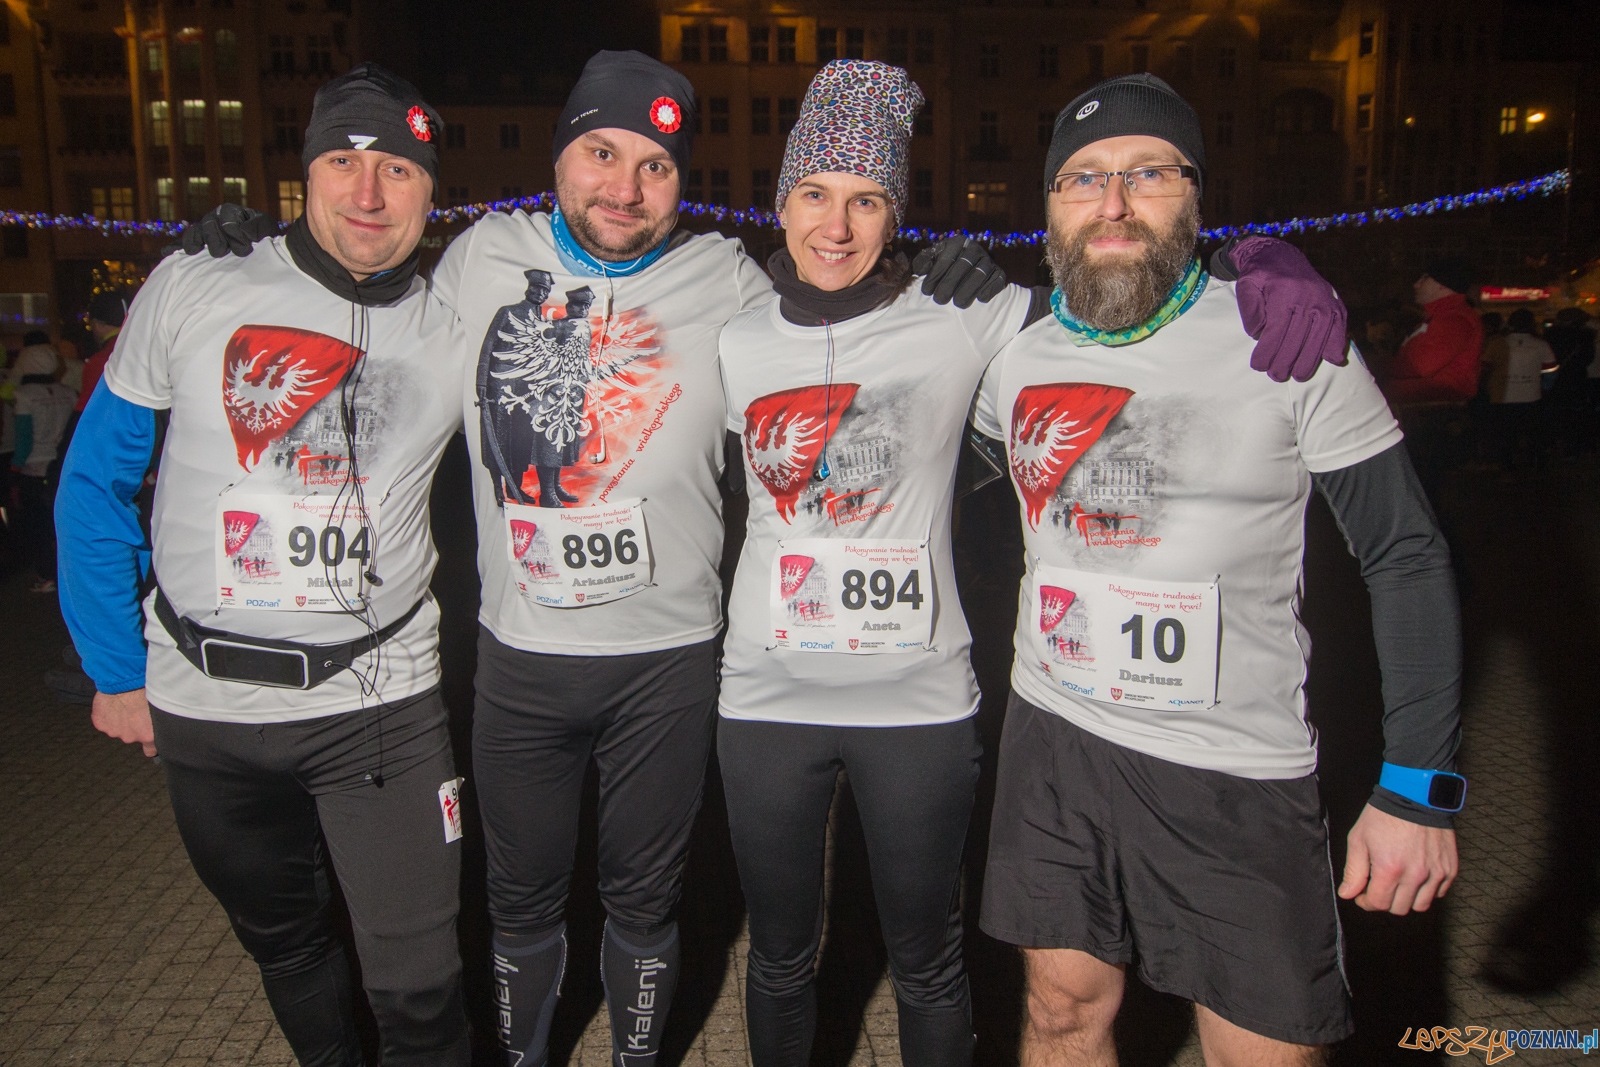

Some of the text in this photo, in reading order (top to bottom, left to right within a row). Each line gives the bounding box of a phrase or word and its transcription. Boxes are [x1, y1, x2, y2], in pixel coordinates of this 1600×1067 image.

[598, 383, 682, 504] powstania wielkopolskiego
[560, 513, 601, 524] Pokonywanie
[840, 502, 895, 525] wielkopolskiego
[583, 521, 603, 531] mamy
[616, 514, 633, 526] krwi!
[1089, 527, 1136, 540] powstania
[1091, 534, 1162, 548] wielkopolskiego
[288, 525, 371, 567] 904
[562, 528, 639, 569] 896
[844, 545, 919, 558] Pokonywanie trudności
[868, 557, 889, 567] mamy
[902, 555, 919, 565] krwi!
[571, 572, 636, 587] Arkadiusz
[841, 569, 924, 611] 894
[1108, 583, 1203, 601] Pokonywanie trudności
[1135, 600, 1161, 613] mamy
[1179, 601, 1203, 613] krwi!
[861, 620, 901, 631] Aneta
[1121, 614, 1186, 664] 10
[1119, 669, 1183, 687] Dariusz
